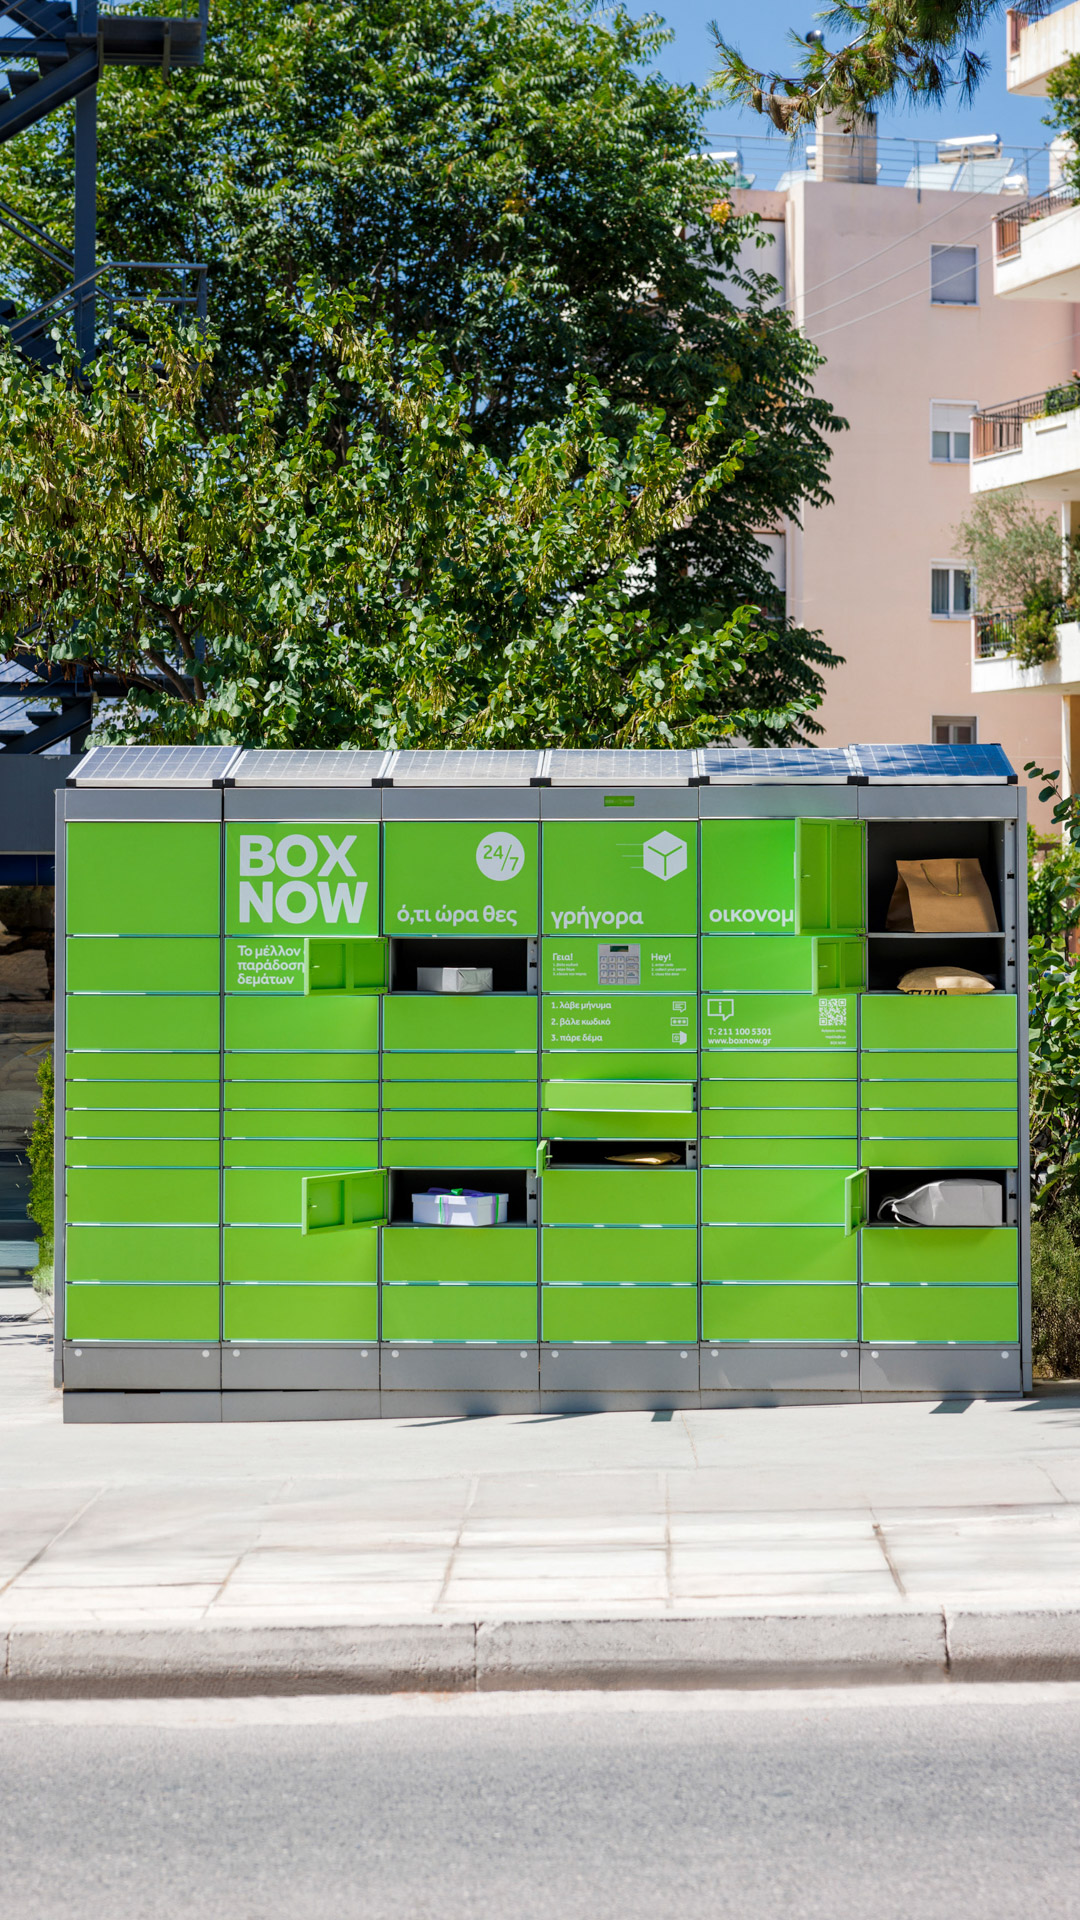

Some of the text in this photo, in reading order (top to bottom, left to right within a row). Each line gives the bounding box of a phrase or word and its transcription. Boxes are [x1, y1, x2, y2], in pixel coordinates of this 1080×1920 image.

[239, 833, 358, 878] BOX
[483, 844, 519, 872] 24/7
[239, 880, 369, 925] NOW
[397, 904, 518, 927] ό,τι ώρα θες
[551, 906, 644, 929] γρήγορα
[237, 945, 302, 960] Το μέλλον
[552, 952, 574, 961] Γεια!
[650, 952, 672, 963] Hey!
[237, 973, 295, 987] δεμάτων
[560, 1001, 580, 1011] λάβε
[581, 1001, 612, 1011] μήνυμα
[551, 1018, 612, 1027] 2. βάλε κωδικό
[708, 1028, 772, 1036] T: 211 100 5301
[551, 1034, 603, 1043] 3. πάρε δέμα
[708, 1037, 772, 1046] www.boxnow.gr
